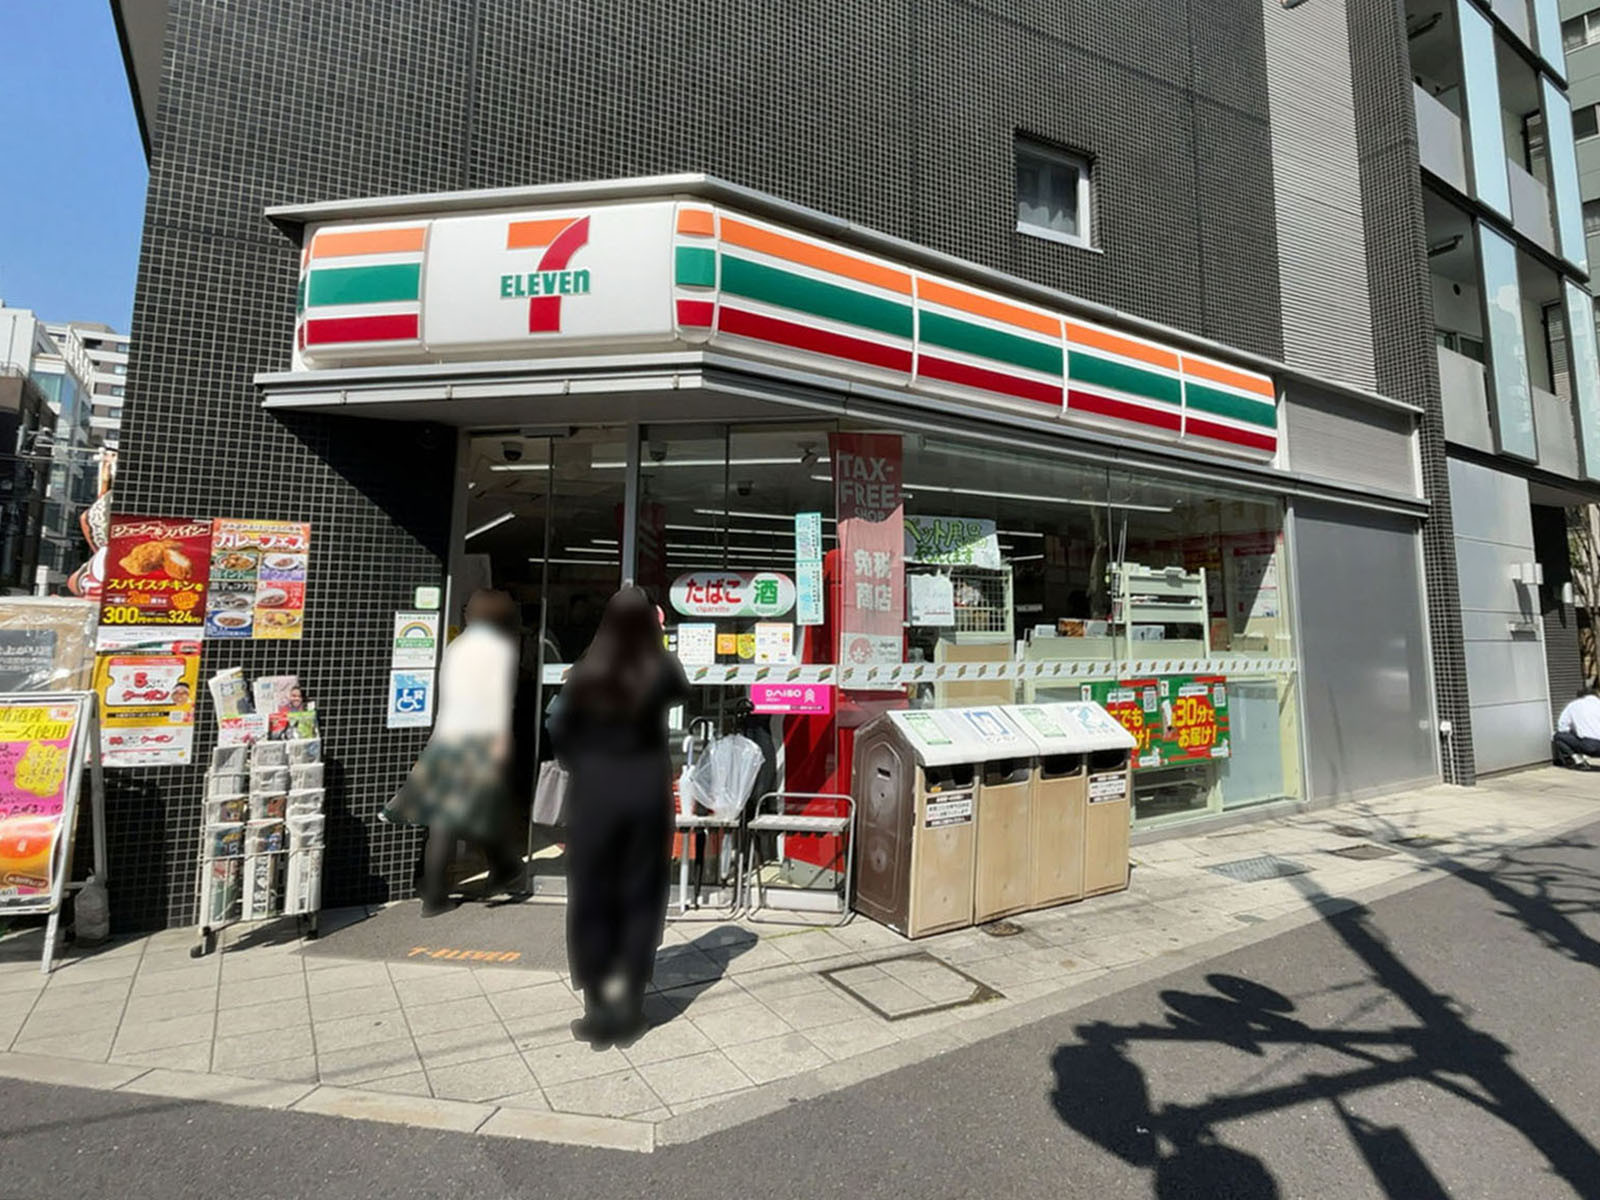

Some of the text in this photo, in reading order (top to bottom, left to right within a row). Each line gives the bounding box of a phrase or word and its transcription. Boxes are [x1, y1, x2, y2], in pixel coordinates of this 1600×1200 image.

[839, 455, 894, 482] TAX-
[840, 481, 896, 508] FREE
[685, 578, 742, 604] たばこ
[753, 579, 779, 604] 酒
